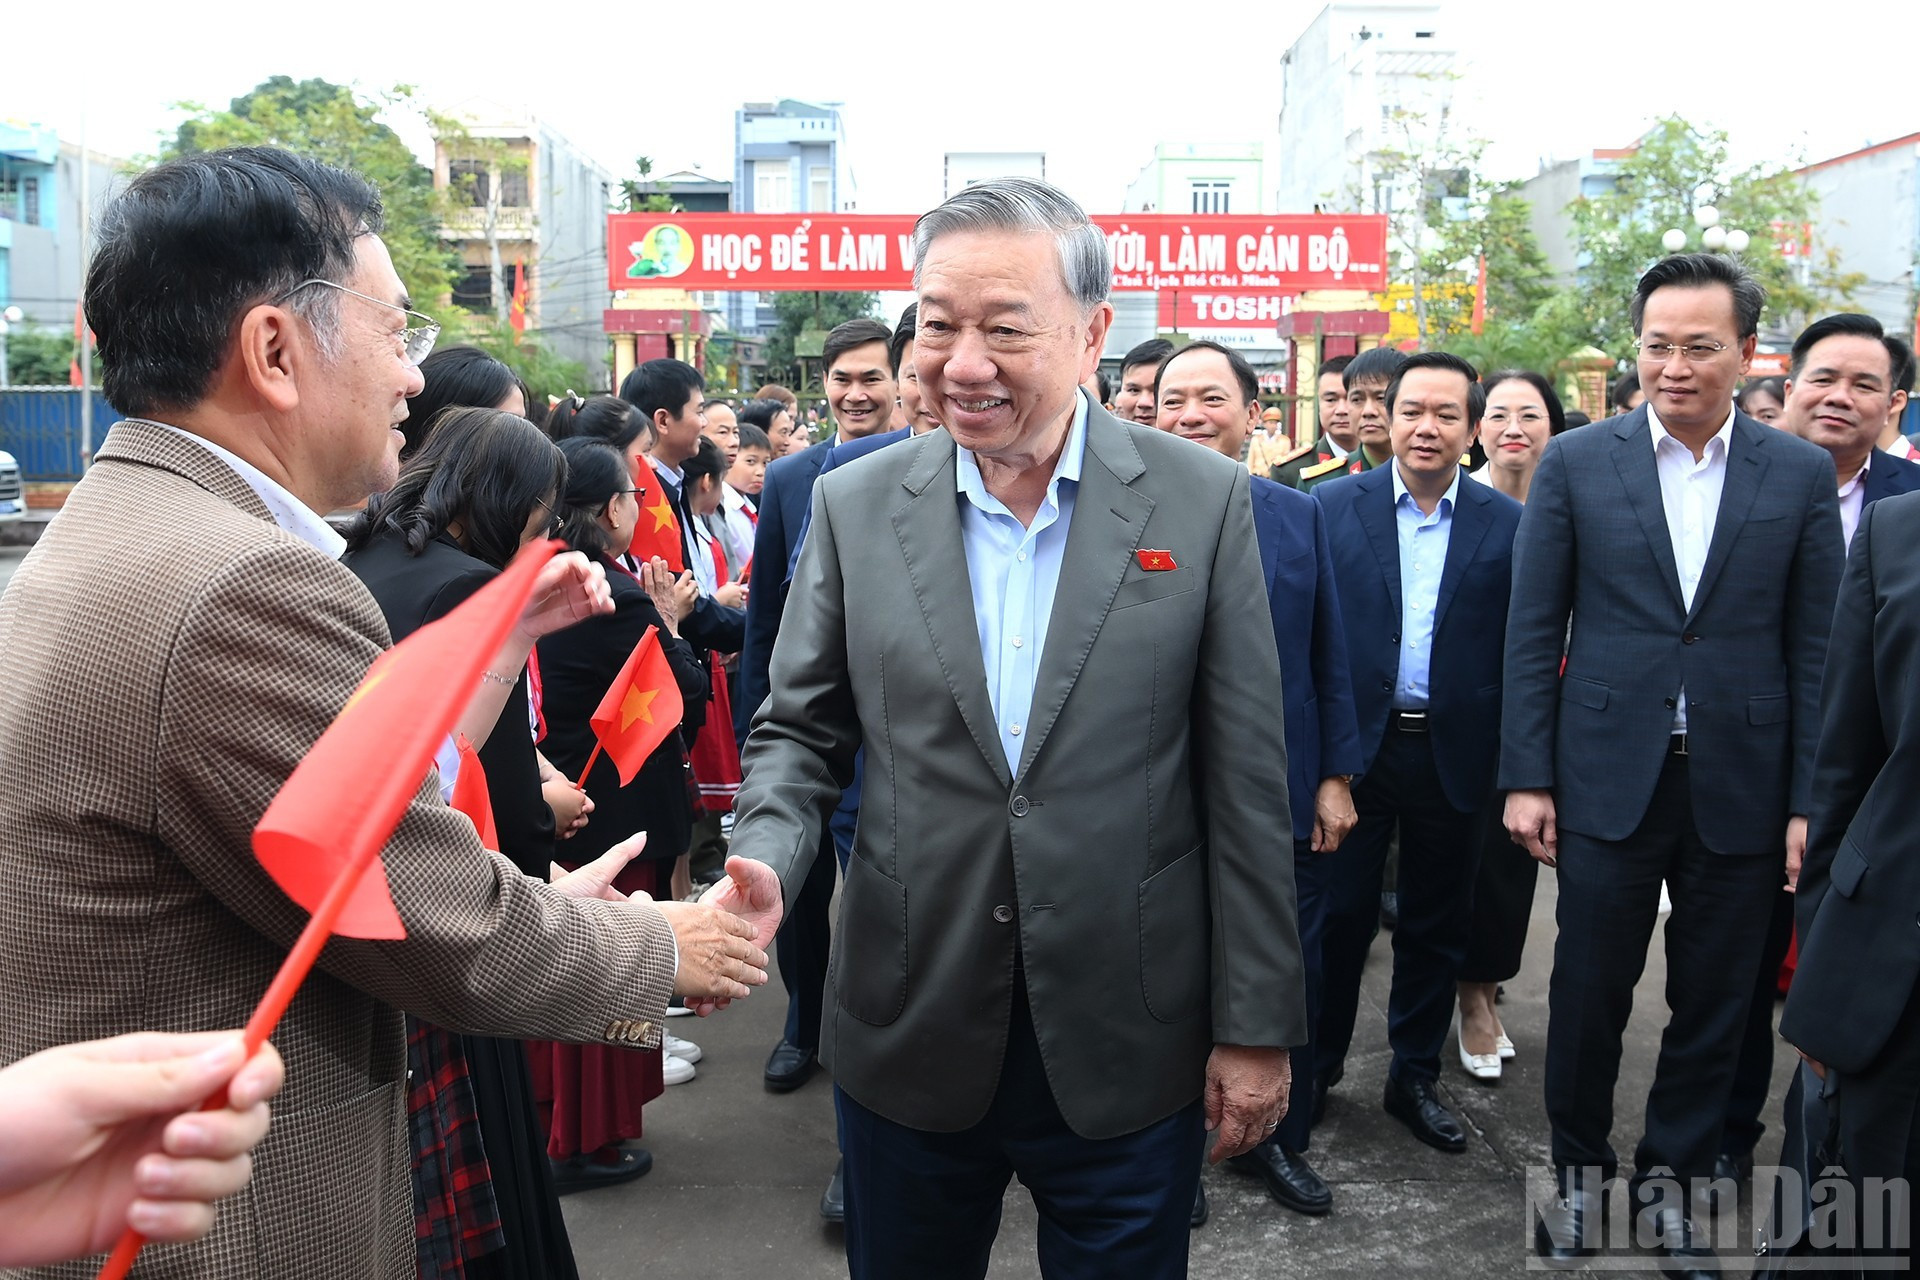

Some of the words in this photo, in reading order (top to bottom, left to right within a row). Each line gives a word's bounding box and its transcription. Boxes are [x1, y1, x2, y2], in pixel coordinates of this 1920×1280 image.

[702, 233, 762, 279] HỌC
[770, 218, 812, 271] ĐỂ
[820, 226, 887, 271] LÀM
[1160, 226, 1226, 272] LÀM
[1236, 226, 1299, 272] CÁN
[1308, 226, 1380, 280] BỘ...
[1241, 274, 1280, 287] Minh
[1191, 295, 1291, 320] TOSHI
